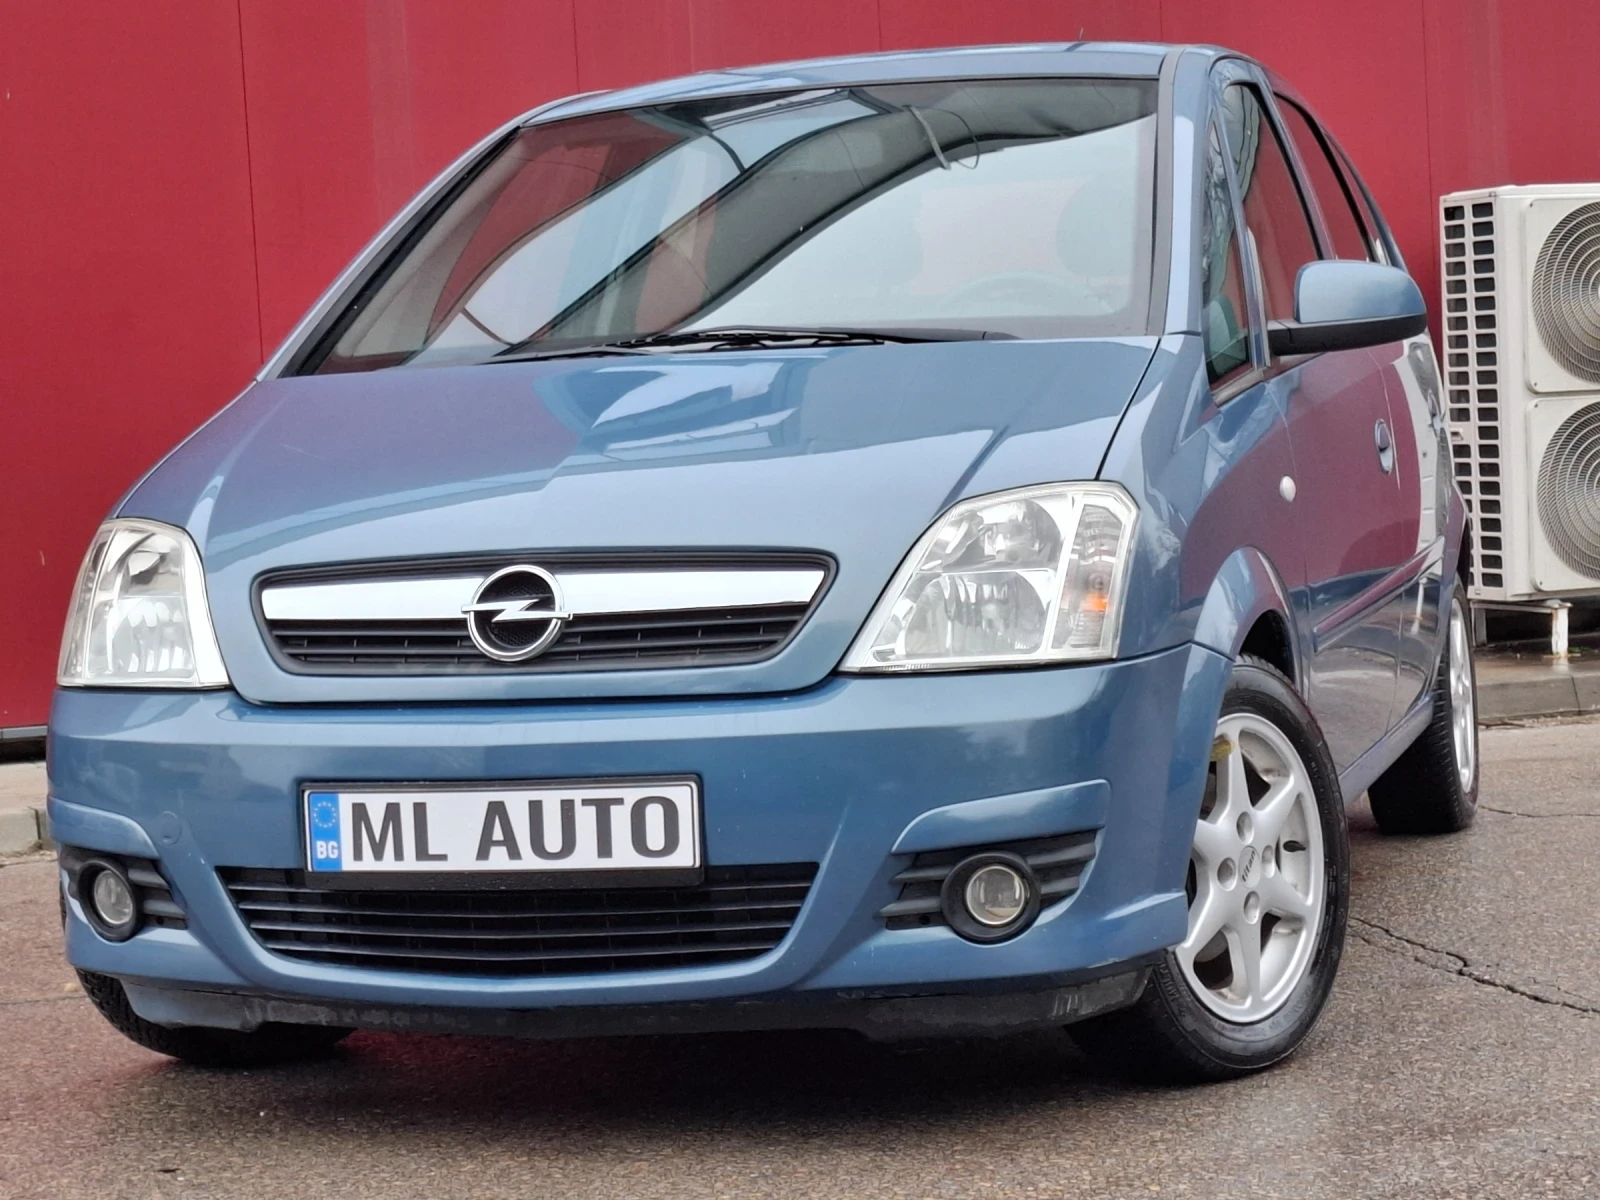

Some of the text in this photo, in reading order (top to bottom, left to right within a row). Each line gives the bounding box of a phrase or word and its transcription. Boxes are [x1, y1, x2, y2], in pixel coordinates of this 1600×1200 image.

[315, 840, 339, 860] BG
[351, 795, 680, 862] ML AUTO
